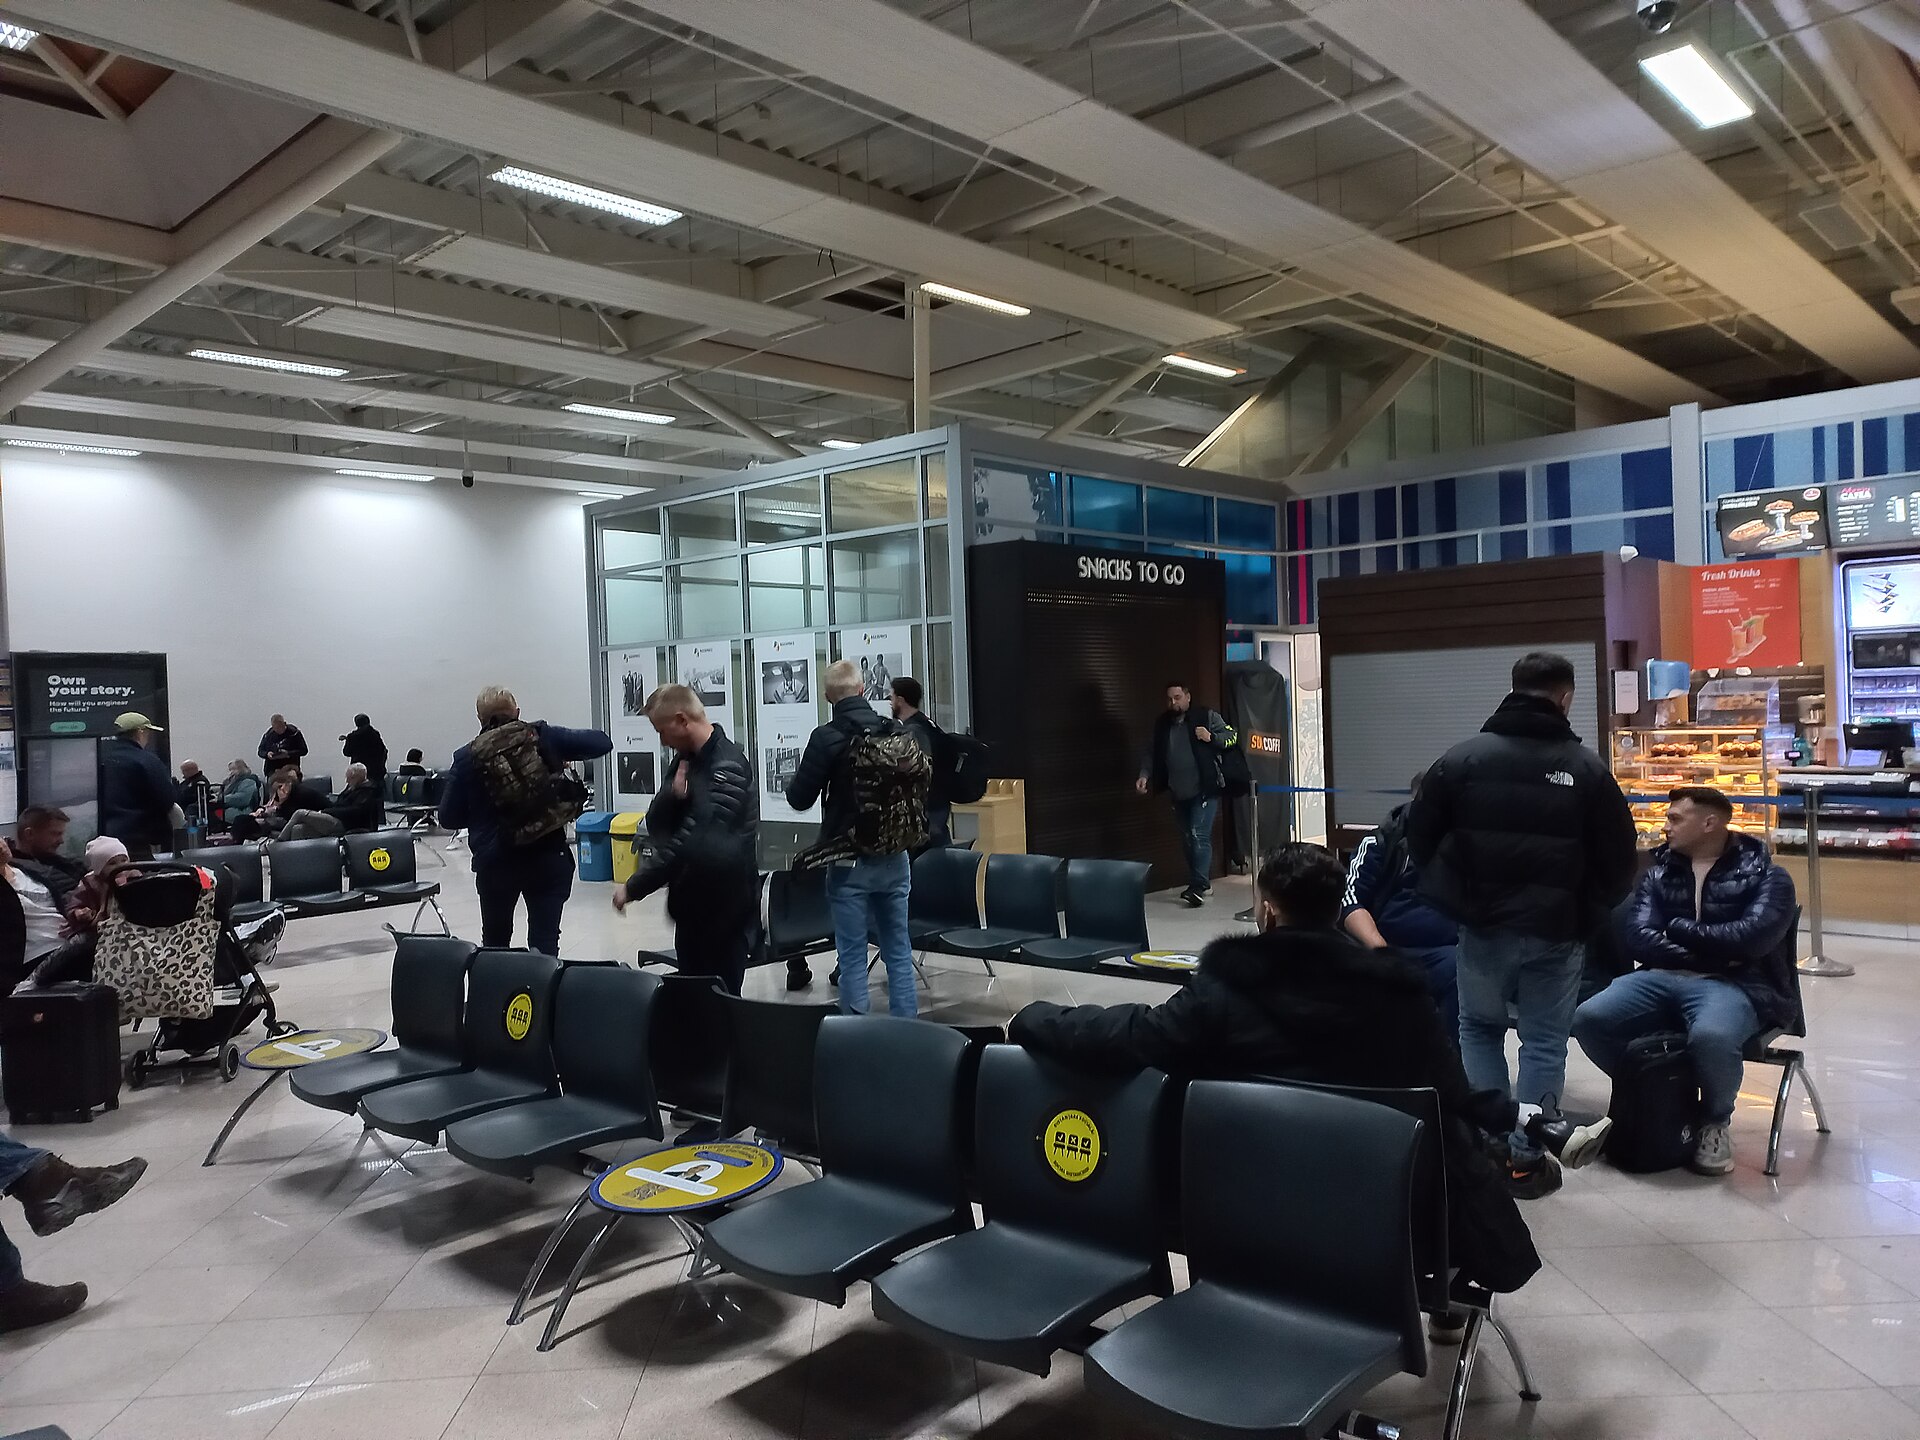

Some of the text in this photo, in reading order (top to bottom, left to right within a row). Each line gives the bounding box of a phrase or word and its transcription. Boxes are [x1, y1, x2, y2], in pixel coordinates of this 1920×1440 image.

[1078, 556, 1185, 585] SNACKS TO GO
[1728, 568, 1761, 578] Drinks
[47, 675, 86, 686] Own
[49, 685, 135, 698] your story.
